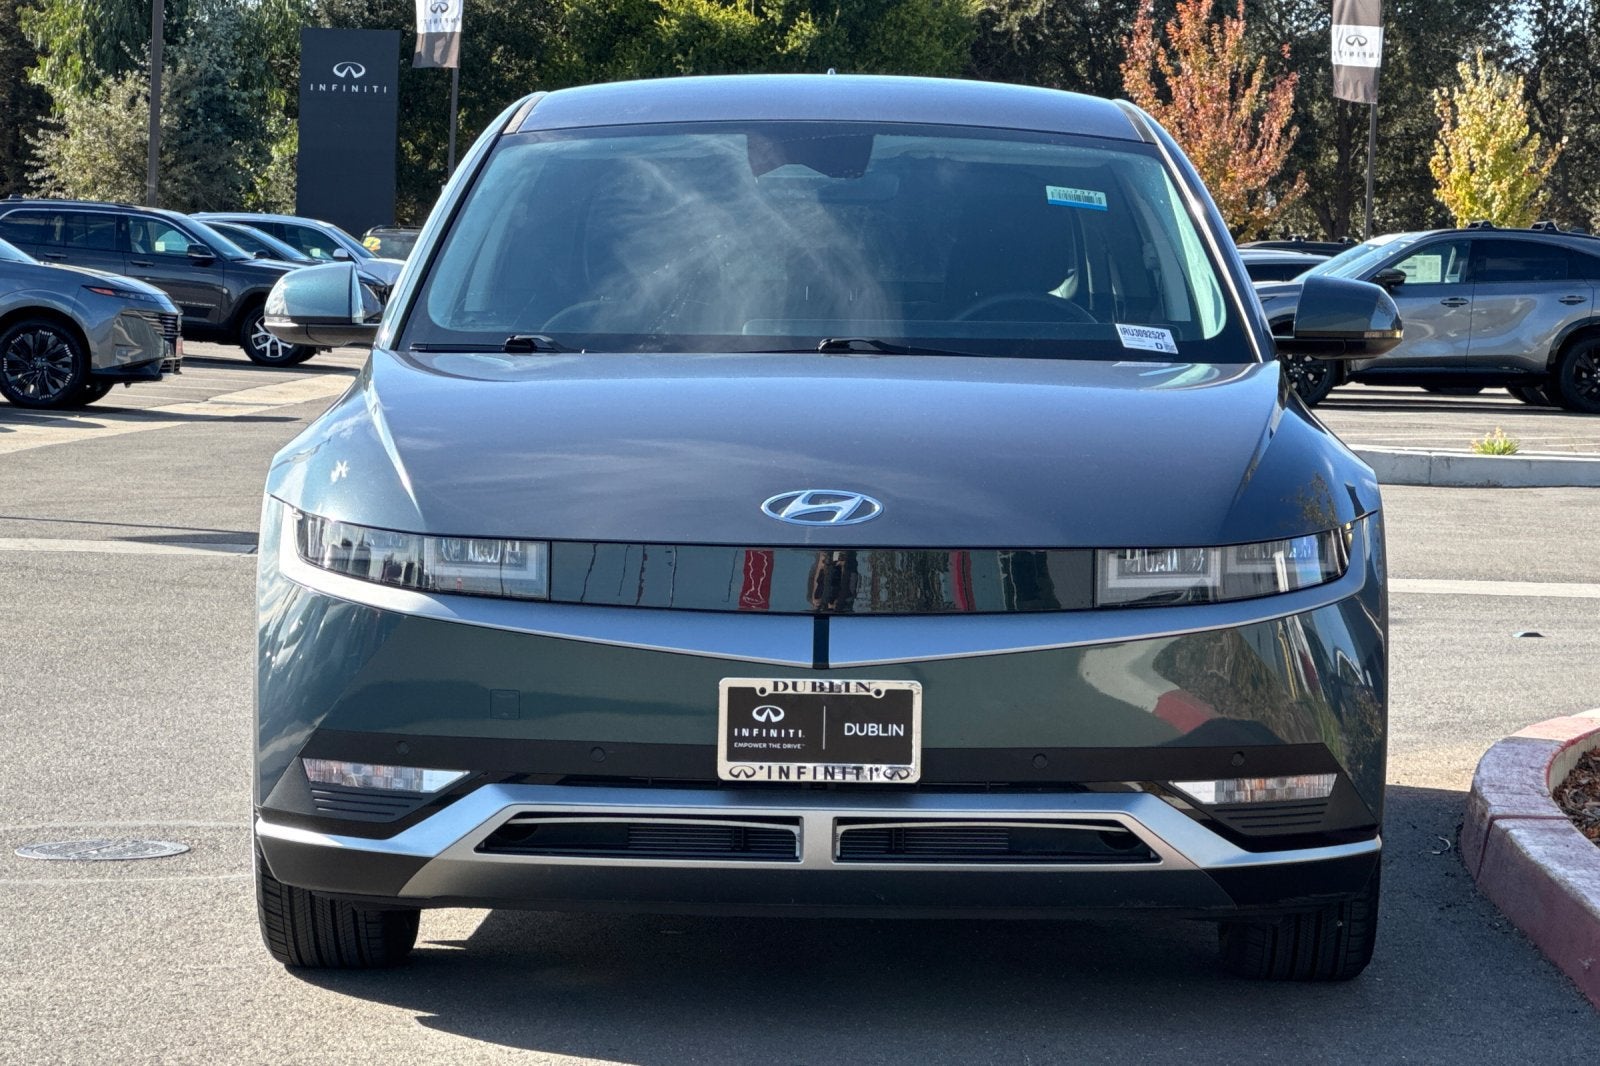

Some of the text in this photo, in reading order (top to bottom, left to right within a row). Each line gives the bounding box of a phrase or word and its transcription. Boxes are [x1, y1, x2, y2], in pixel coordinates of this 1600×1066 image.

[310, 83, 387, 93] INFINITI
[772, 680, 872, 693] DUBLIN
[734, 727, 802, 738] INFINITI
[844, 722, 904, 737] DUBLIN
[767, 765, 874, 781] INFINITI
